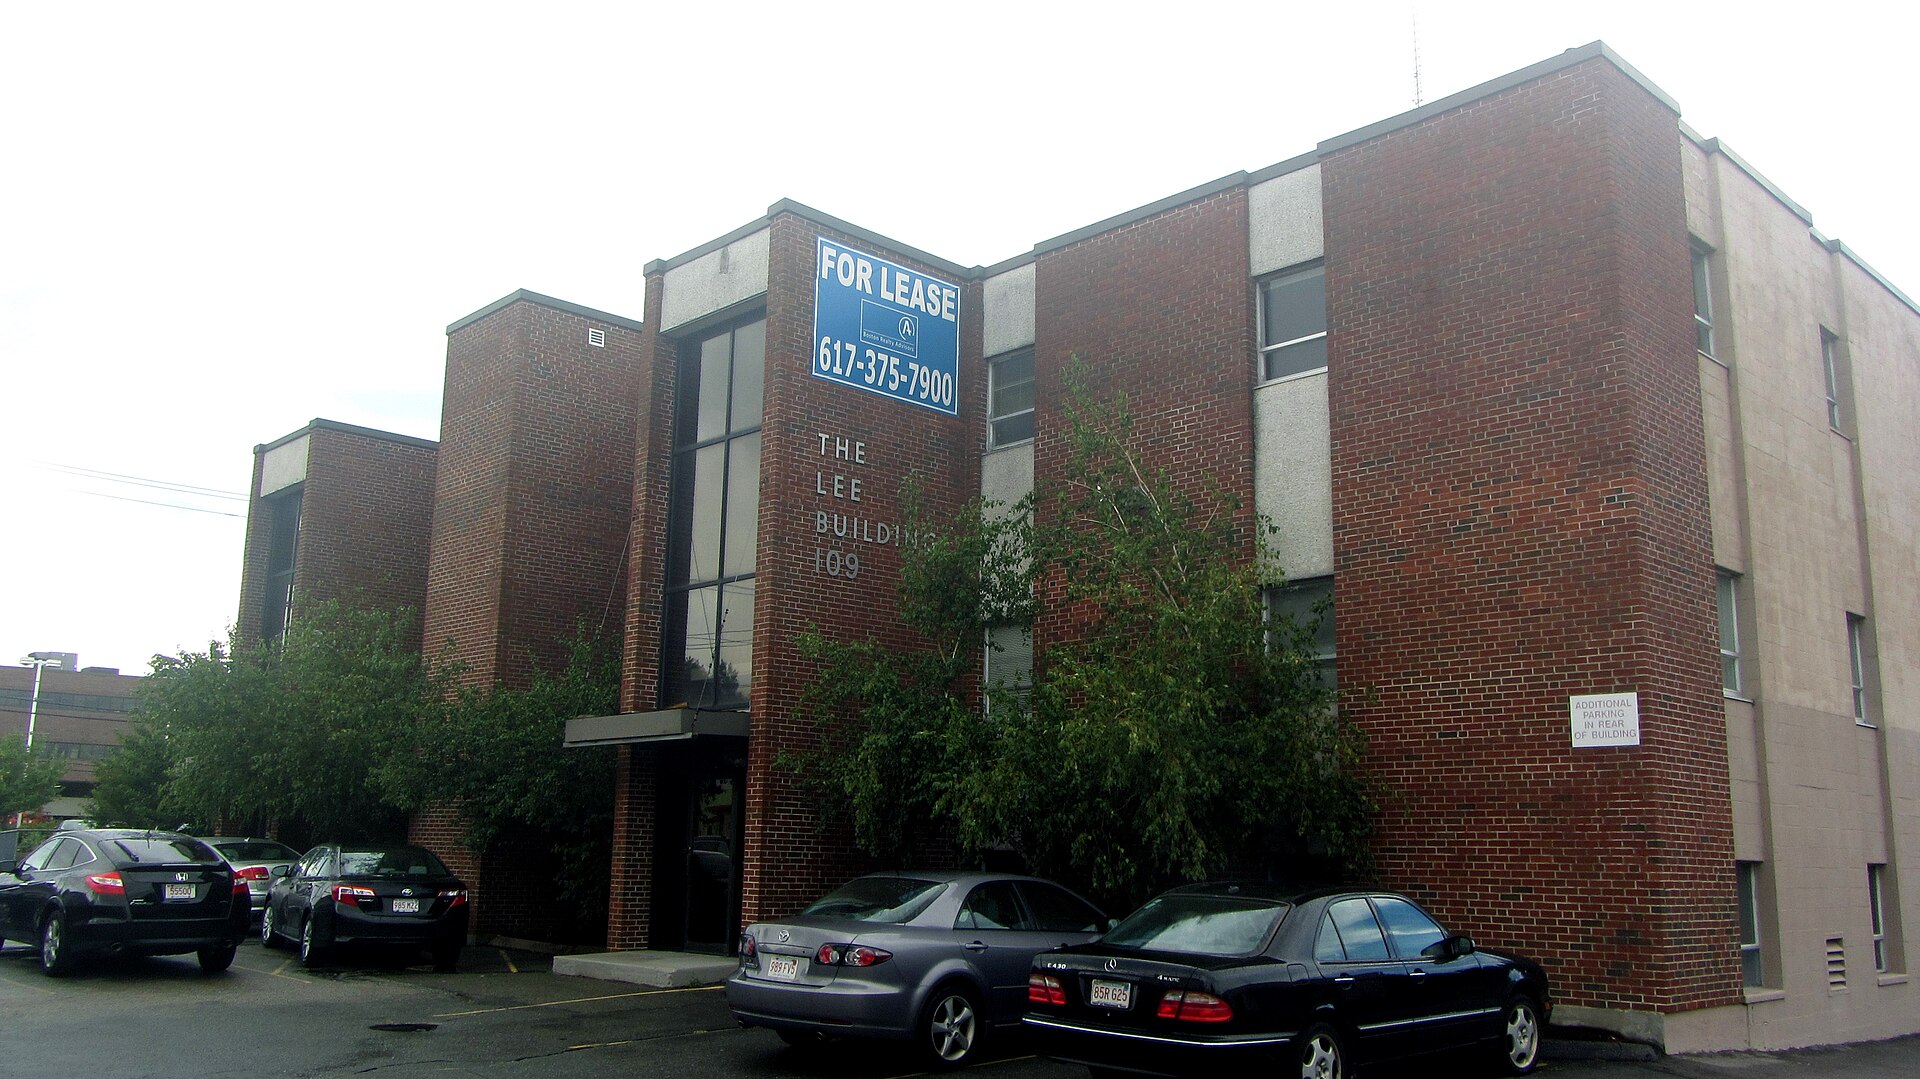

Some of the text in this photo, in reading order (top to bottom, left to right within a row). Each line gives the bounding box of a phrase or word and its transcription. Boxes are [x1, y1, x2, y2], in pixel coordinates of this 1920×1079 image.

[821, 245, 956, 323] FOR LEASE
[819, 335, 953, 407] 617-375-7900
[818, 432, 865, 464] THE
[816, 471, 861, 502] LEE
[815, 547, 859, 579] 109
[1575, 699, 1632, 710] ADDITIONAL
[1583, 709, 1625, 719] PARKING
[1574, 729, 1637, 740] OF BUILDING
[1584, 720, 1624, 729] IN REAR
[1093, 986, 1128, 1002] 85R G25
